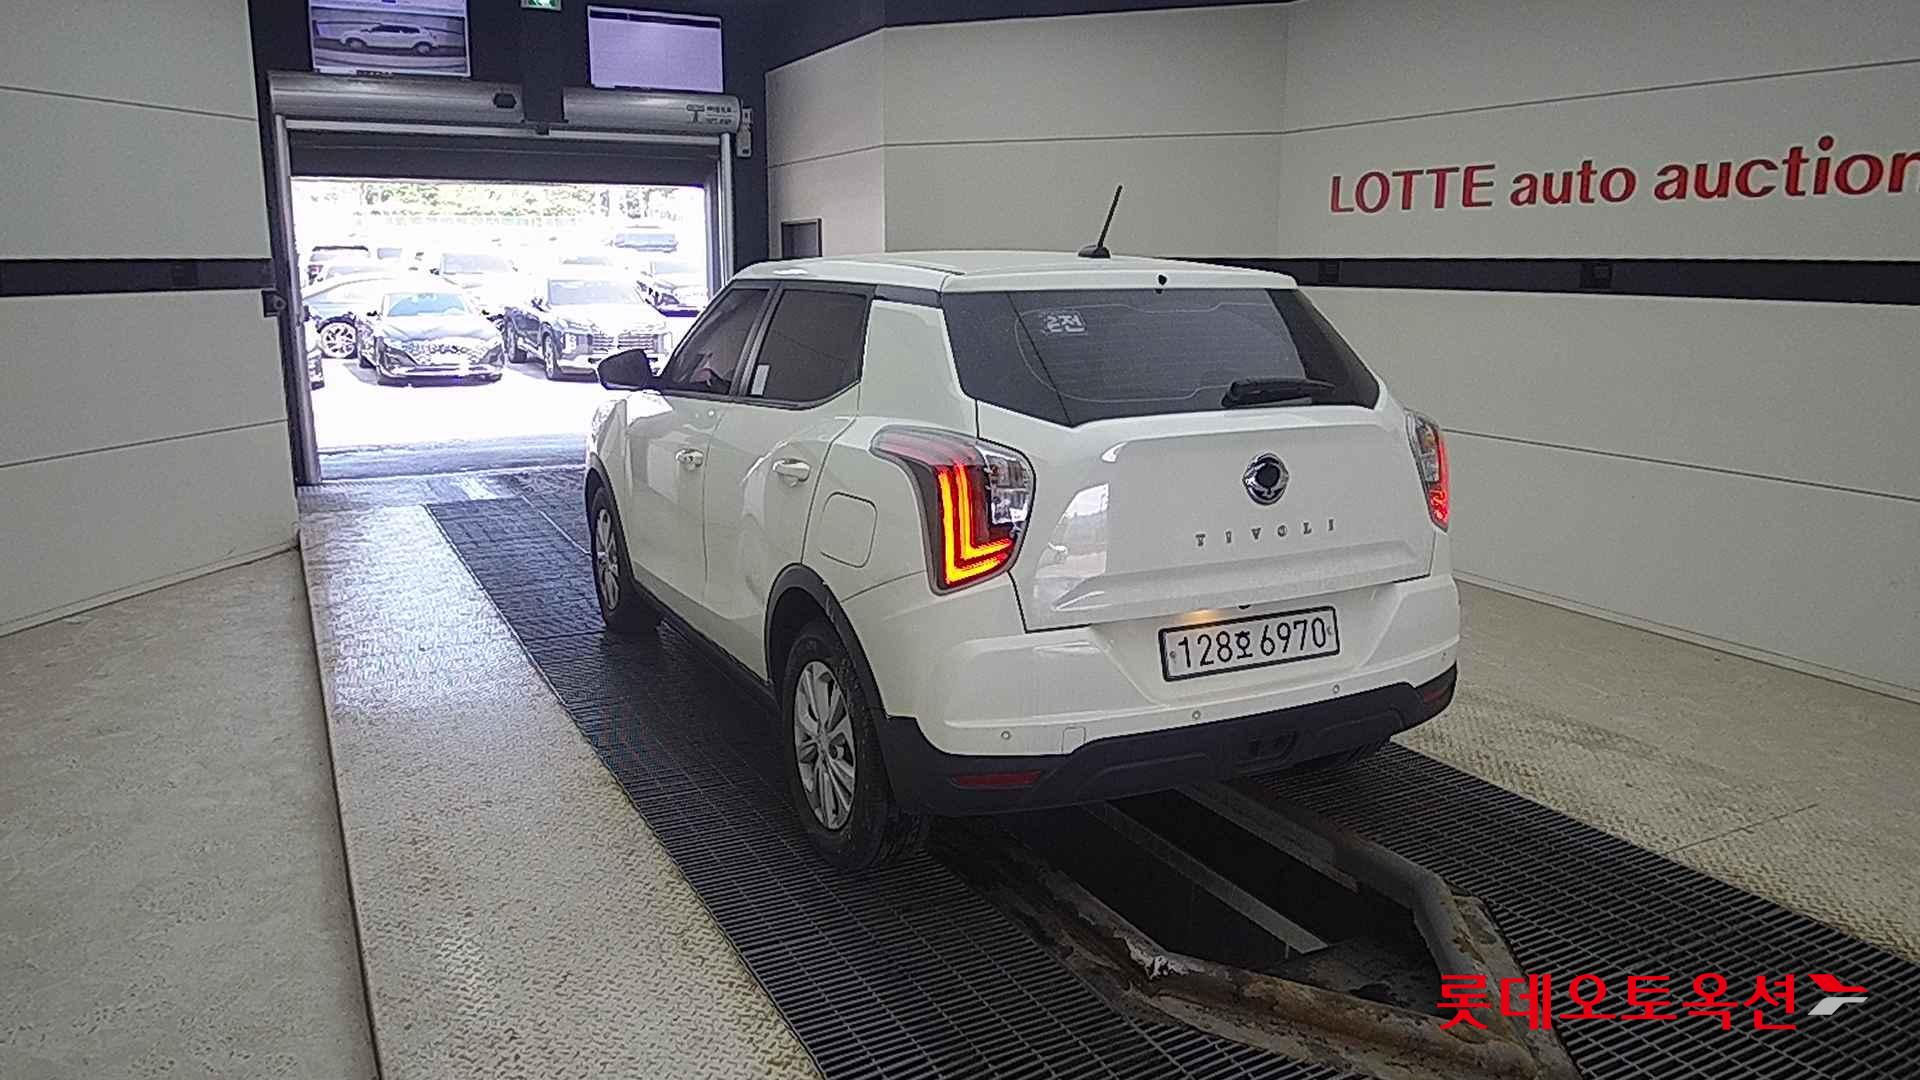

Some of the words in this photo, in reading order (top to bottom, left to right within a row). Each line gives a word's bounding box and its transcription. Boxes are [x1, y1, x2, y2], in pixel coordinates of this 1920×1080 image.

[1330, 163, 1497, 214] LOTTE
[1510, 159, 1637, 206] auto
[1195, 518, 1336, 547] TIVOLI
[1260, 617, 1327, 657] 6970
